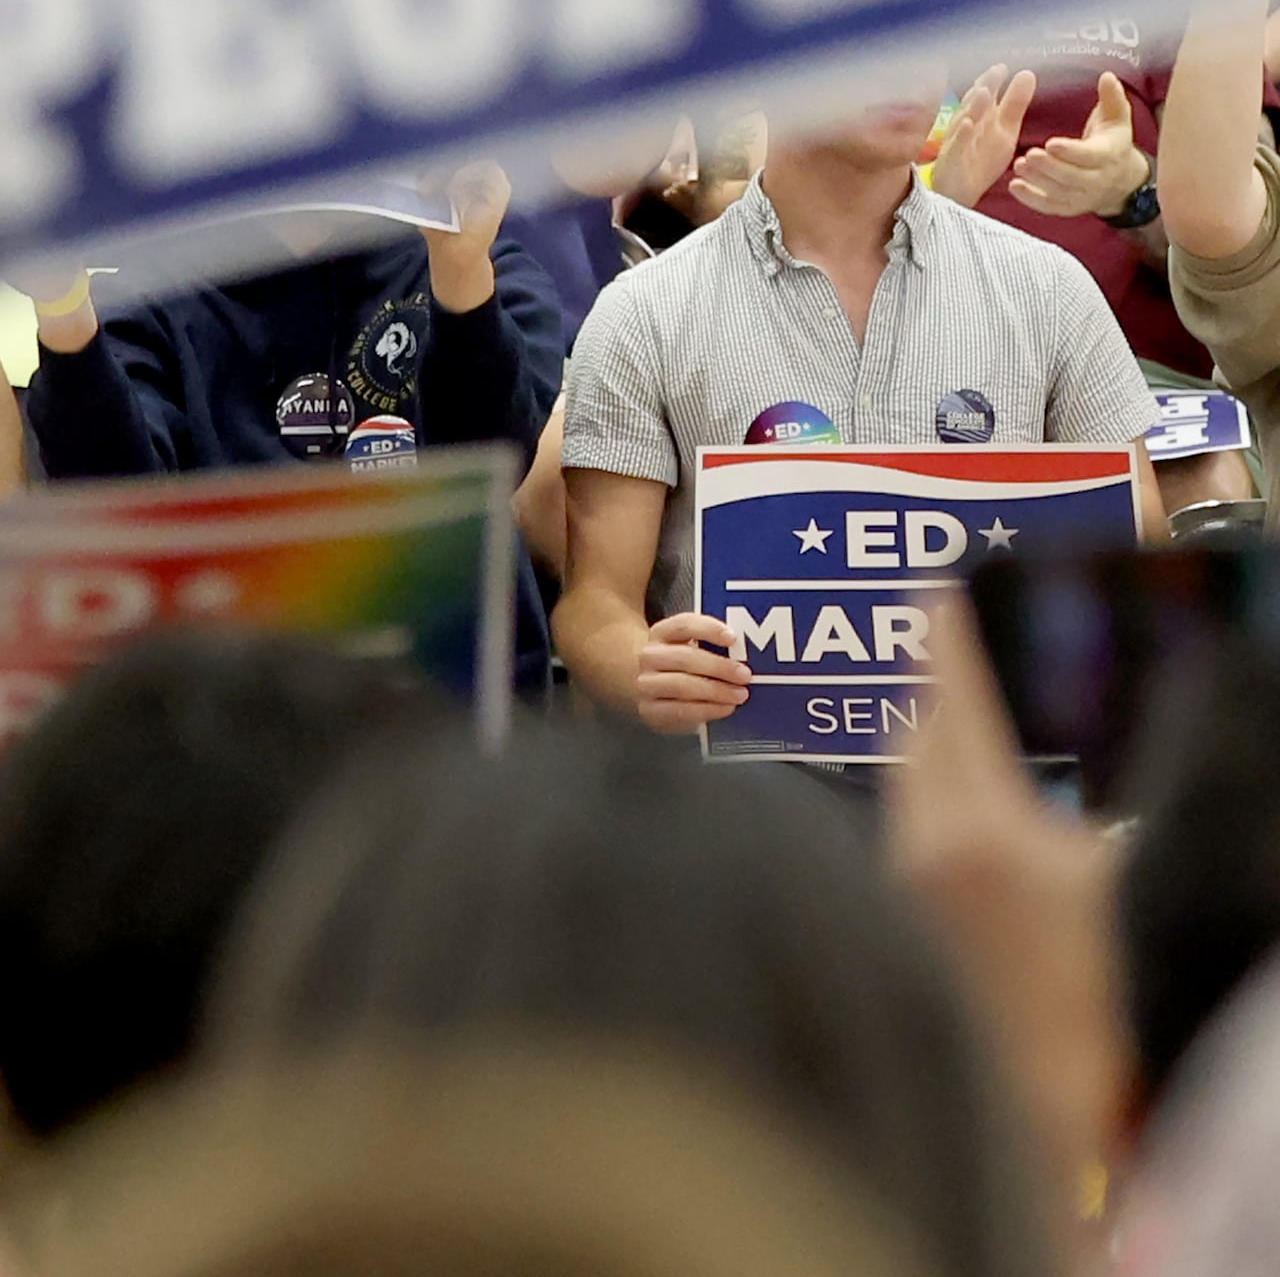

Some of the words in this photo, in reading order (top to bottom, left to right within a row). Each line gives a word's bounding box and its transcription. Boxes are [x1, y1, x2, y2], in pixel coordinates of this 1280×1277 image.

[370, 439, 394, 455] ED
[774, 421, 802, 439] ED
[844, 509, 969, 570] ED
[725, 604, 934, 664] MAR
[805, 696, 920, 736] SEN
